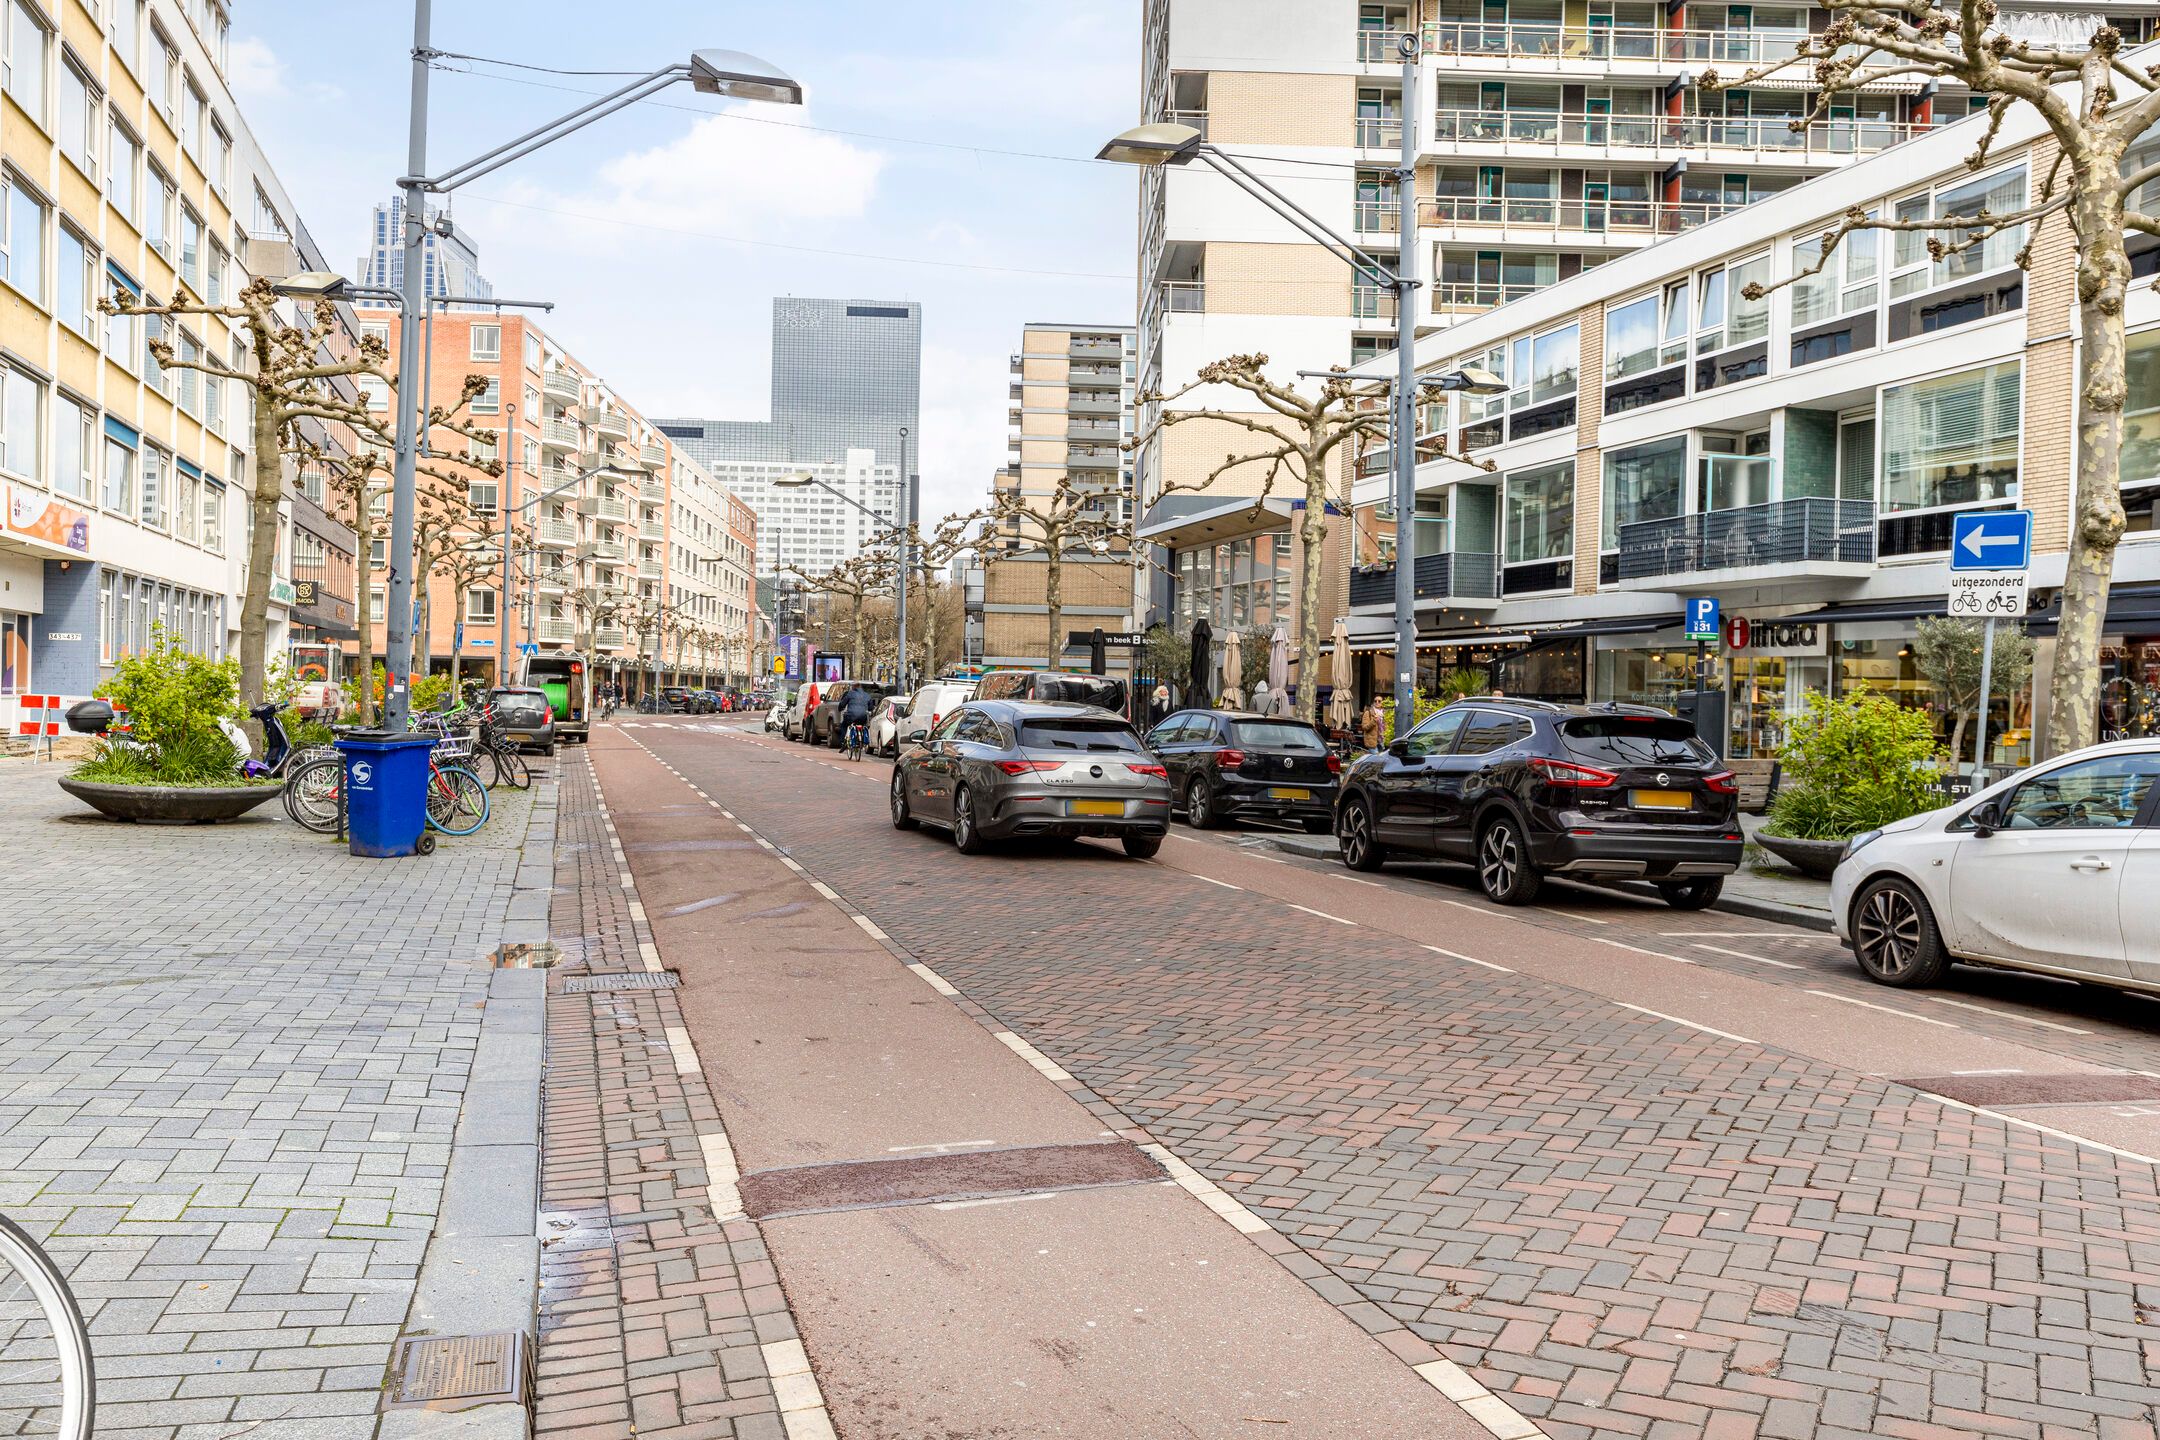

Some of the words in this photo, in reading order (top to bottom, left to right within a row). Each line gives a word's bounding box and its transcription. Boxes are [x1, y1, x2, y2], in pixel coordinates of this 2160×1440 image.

[1951, 576, 2024, 590] uitgezonderd
[1698, 600, 1713, 619] P
[1699, 623, 1711, 632] 31
[1113, 636, 1131, 644] beek
